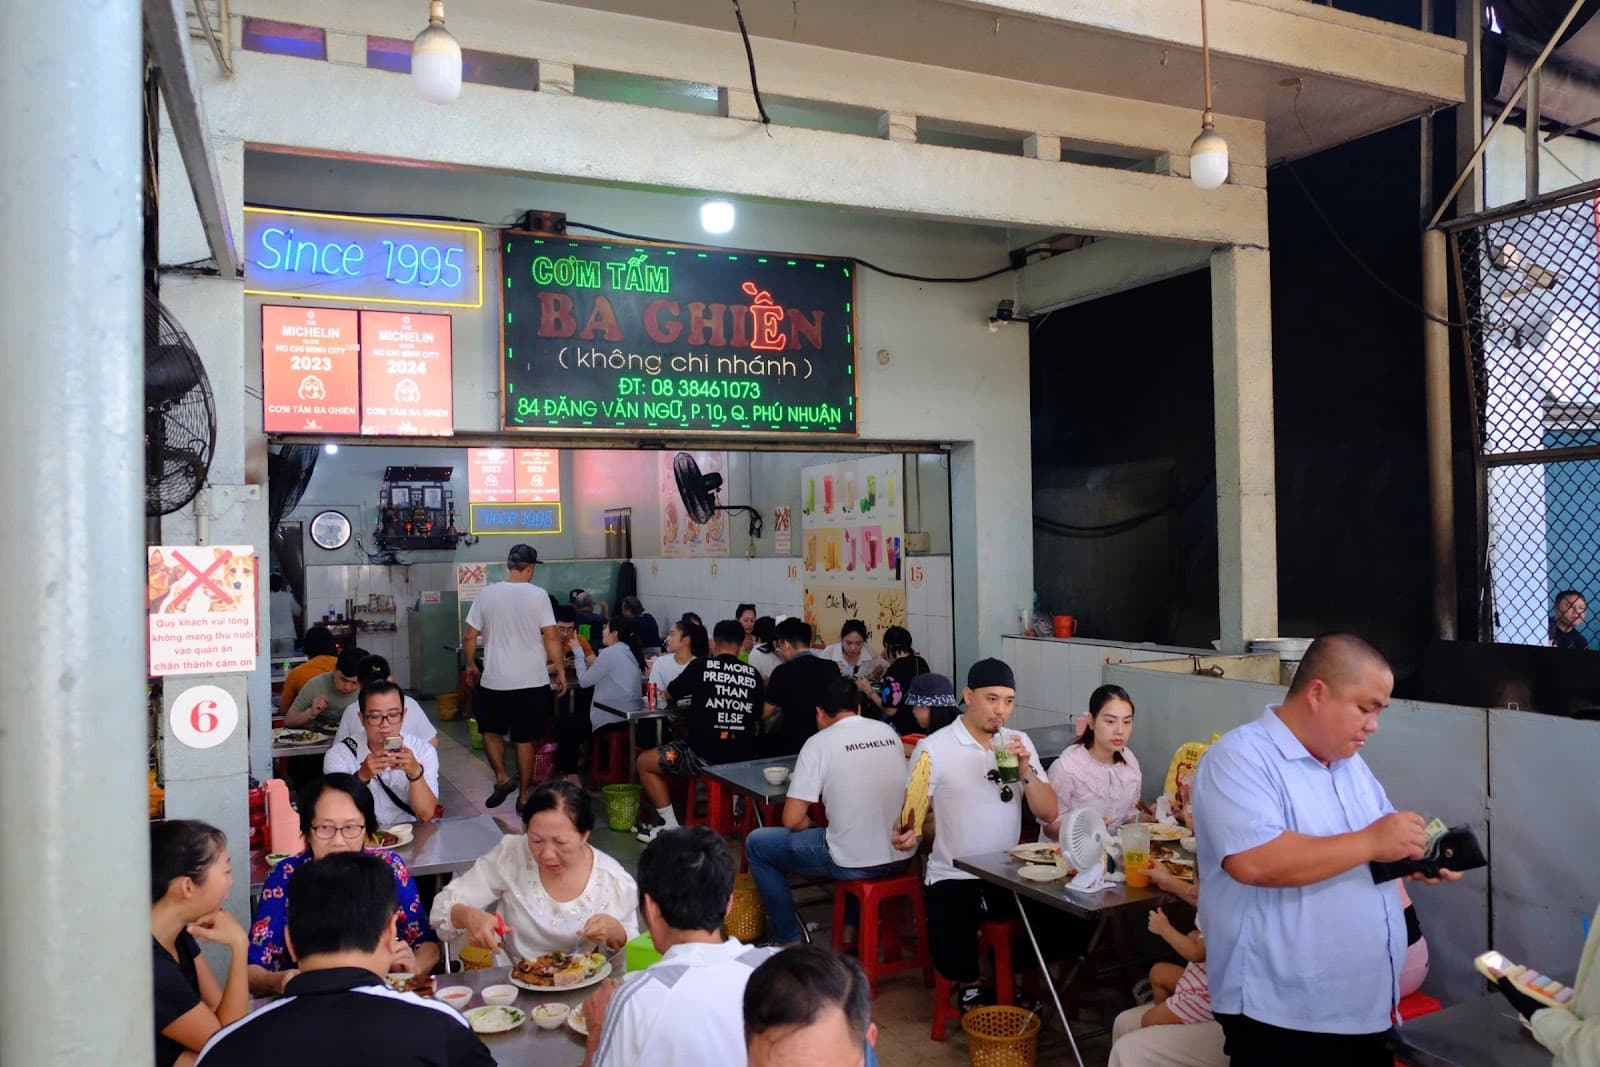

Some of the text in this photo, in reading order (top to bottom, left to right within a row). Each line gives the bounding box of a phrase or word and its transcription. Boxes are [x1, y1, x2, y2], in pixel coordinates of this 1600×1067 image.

[257, 228, 464, 287] Since 1995
[532, 254, 670, 293] CƠM TẤM
[537, 282, 825, 351] BA GHIỀN
[281, 325, 340, 338] MICHELIN
[379, 330, 434, 343] MICHELIN
[305, 345, 326, 353] MINH
[327, 346, 345, 354] CITY
[422, 351, 440, 359] CITY
[290, 356, 332, 371] 2023
[387, 360, 427, 374] 2024
[577, 348, 662, 375] không
[671, 352, 709, 373] chi
[717, 354, 796, 377] nhánh
[618, 378, 760, 399] ĐT: 08 38461073
[314, 405, 327, 414] BA
[409, 407, 422, 416] BA
[517, 398, 540, 416] 84
[544, 395, 598, 419] ĐẶNG
[601, 398, 639, 418] VĂN
[731, 405, 748, 420] Q.
[753, 401, 783, 421] PHÚ
[788, 403, 841, 425] NHUẬN
[480, 508, 553, 529] Since 1995
[911, 566, 923, 581] 15
[424, 592, 439, 600] WC
[179, 618, 208, 626] khách
[211, 617, 225, 625] vui
[228, 616, 249, 626] lòng
[186, 633, 212, 641] mang
[706, 659, 755, 676] BE MORE
[703, 671, 756, 688] PREPARED
[715, 684, 748, 699] THAN
[705, 697, 753, 713] ANYONE
[190, 700, 218, 733] 6
[718, 711, 744, 724] ELSE
[845, 739, 897, 752] MICHELIN
